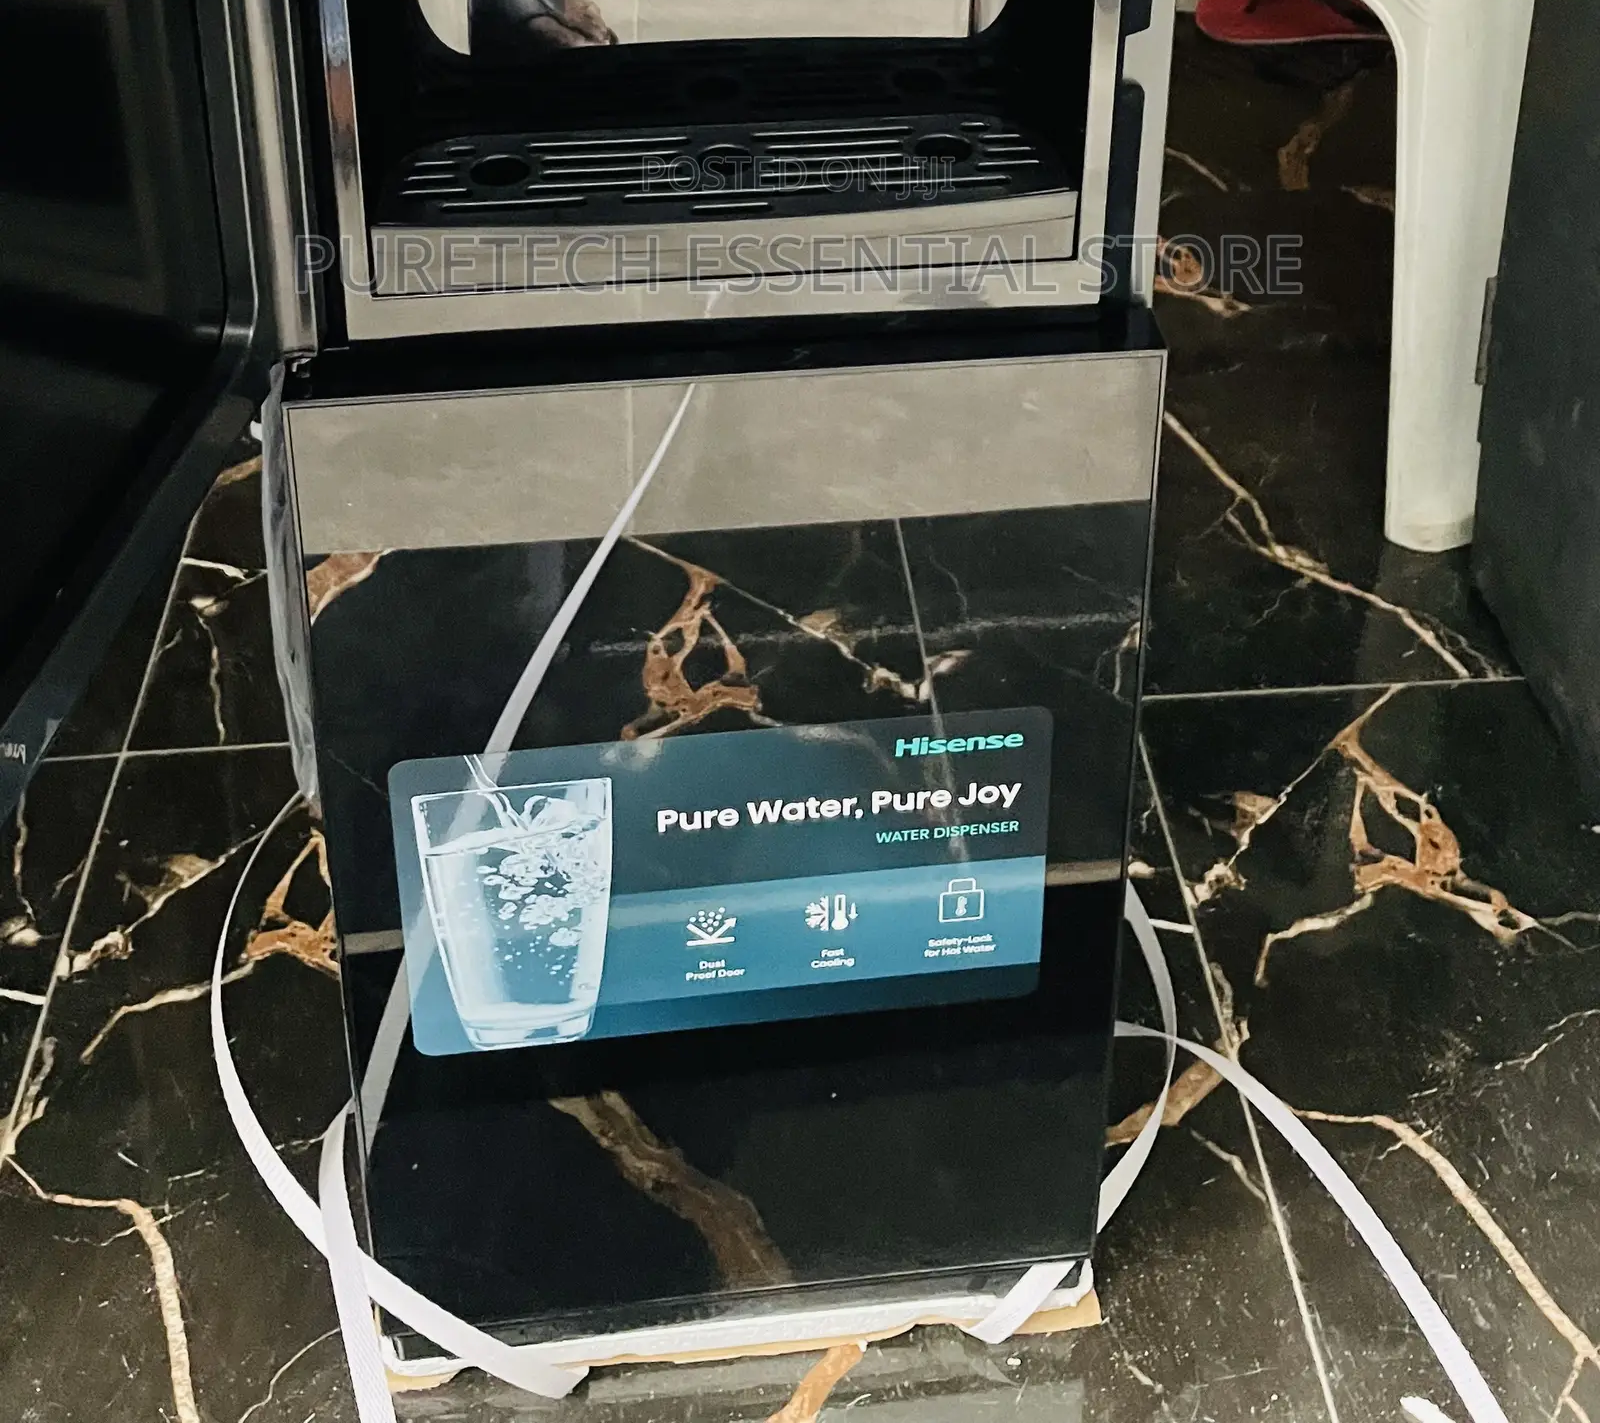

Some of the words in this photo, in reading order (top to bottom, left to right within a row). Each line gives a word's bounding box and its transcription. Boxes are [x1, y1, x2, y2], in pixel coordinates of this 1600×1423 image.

[895, 733, 1024, 757] Hisense
[656, 806, 740, 833] Pure
[747, 795, 864, 825] Water,
[870, 787, 953, 816] Pure
[958, 782, 1022, 808] Joy
[876, 828, 930, 844] WATER
[933, 821, 1020, 840] DISPENSER
[820, 948, 844, 958] Fast
[810, 957, 856, 969] Cooling
[685, 970, 717, 981] Proof
[717, 968, 746, 978] Door
